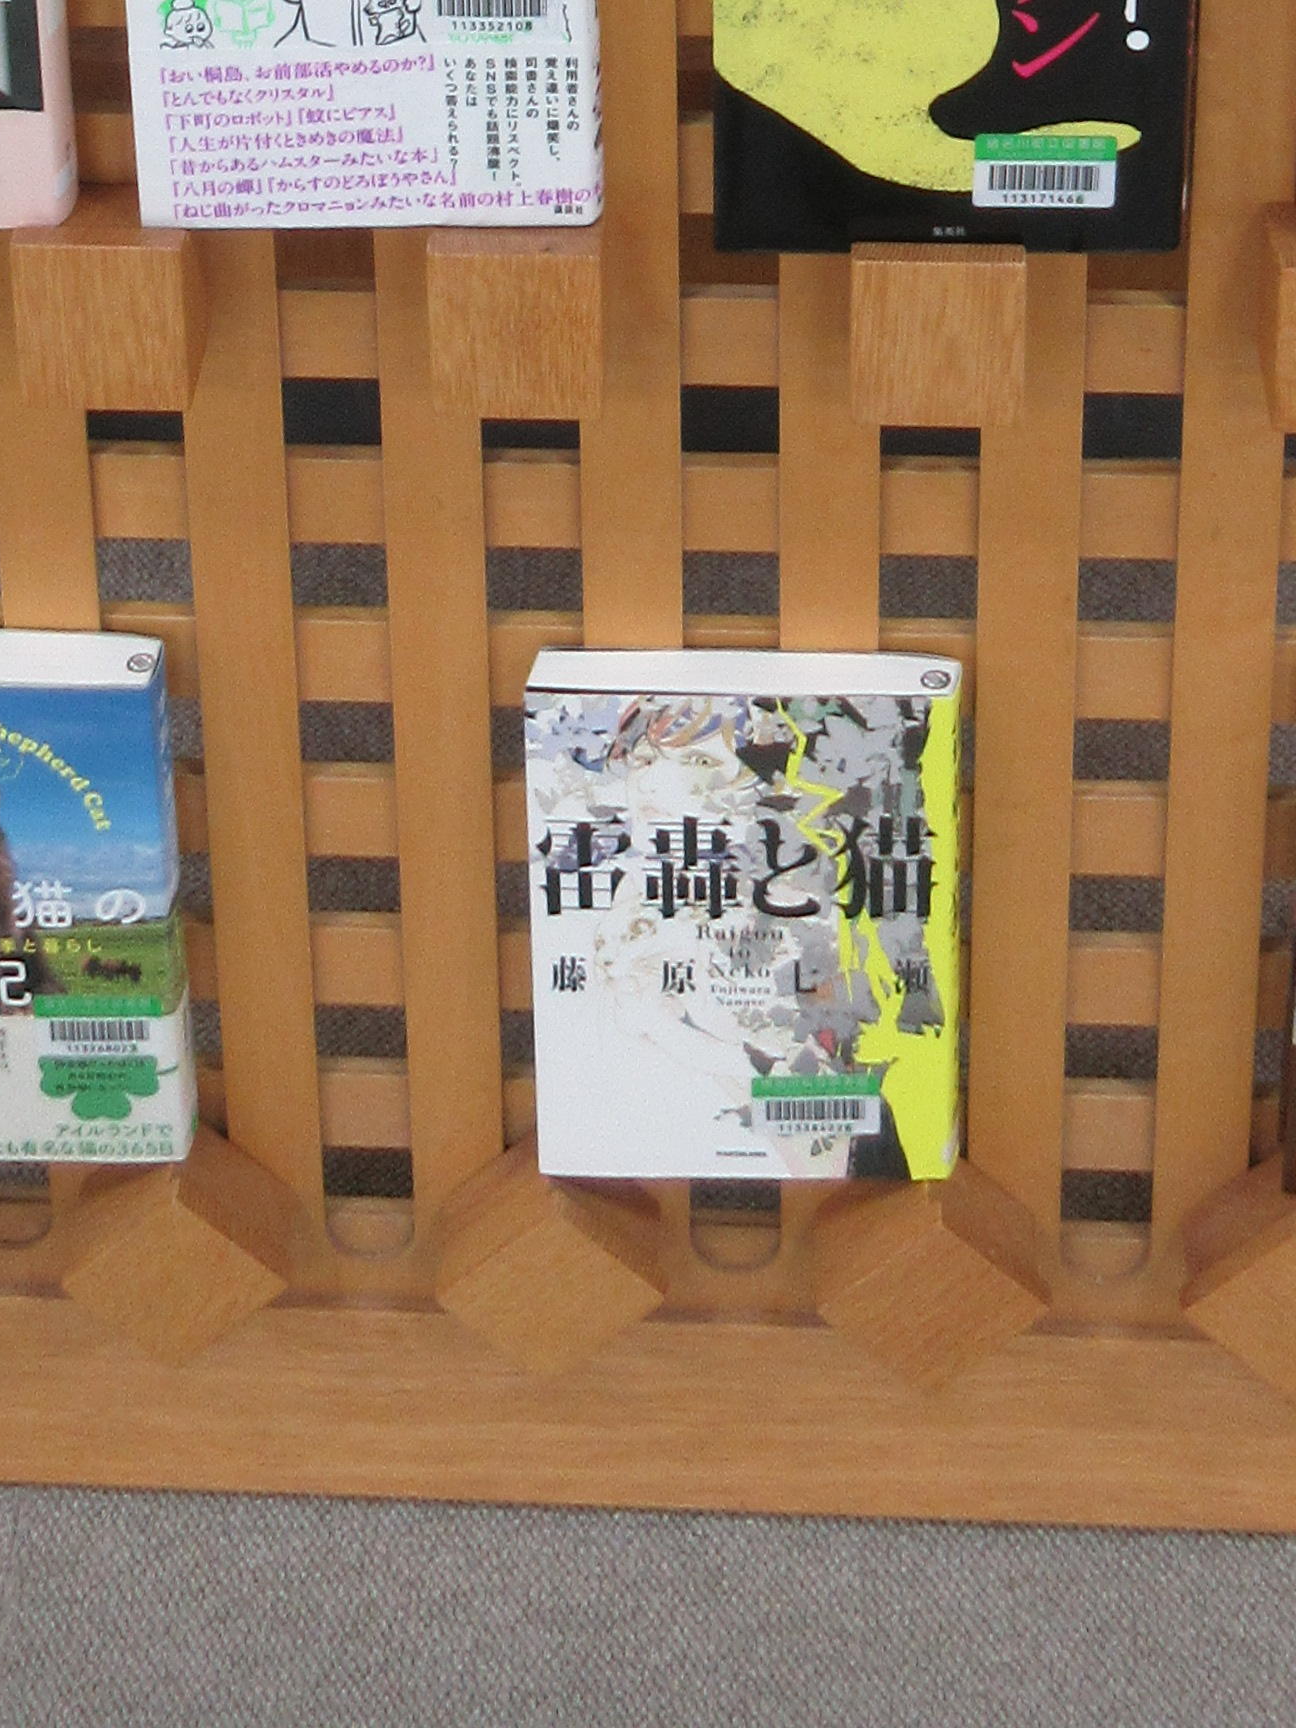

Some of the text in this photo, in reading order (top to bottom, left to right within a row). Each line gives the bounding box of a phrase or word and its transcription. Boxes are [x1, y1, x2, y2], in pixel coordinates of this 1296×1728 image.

[451, 20, 534, 32] 113352108
[464, 58, 478, 107] あなたは
[525, 57, 540, 119] 司書さんの
[565, 57, 580, 131] 利用者さんの
[83, 791, 112, 832] Cat
